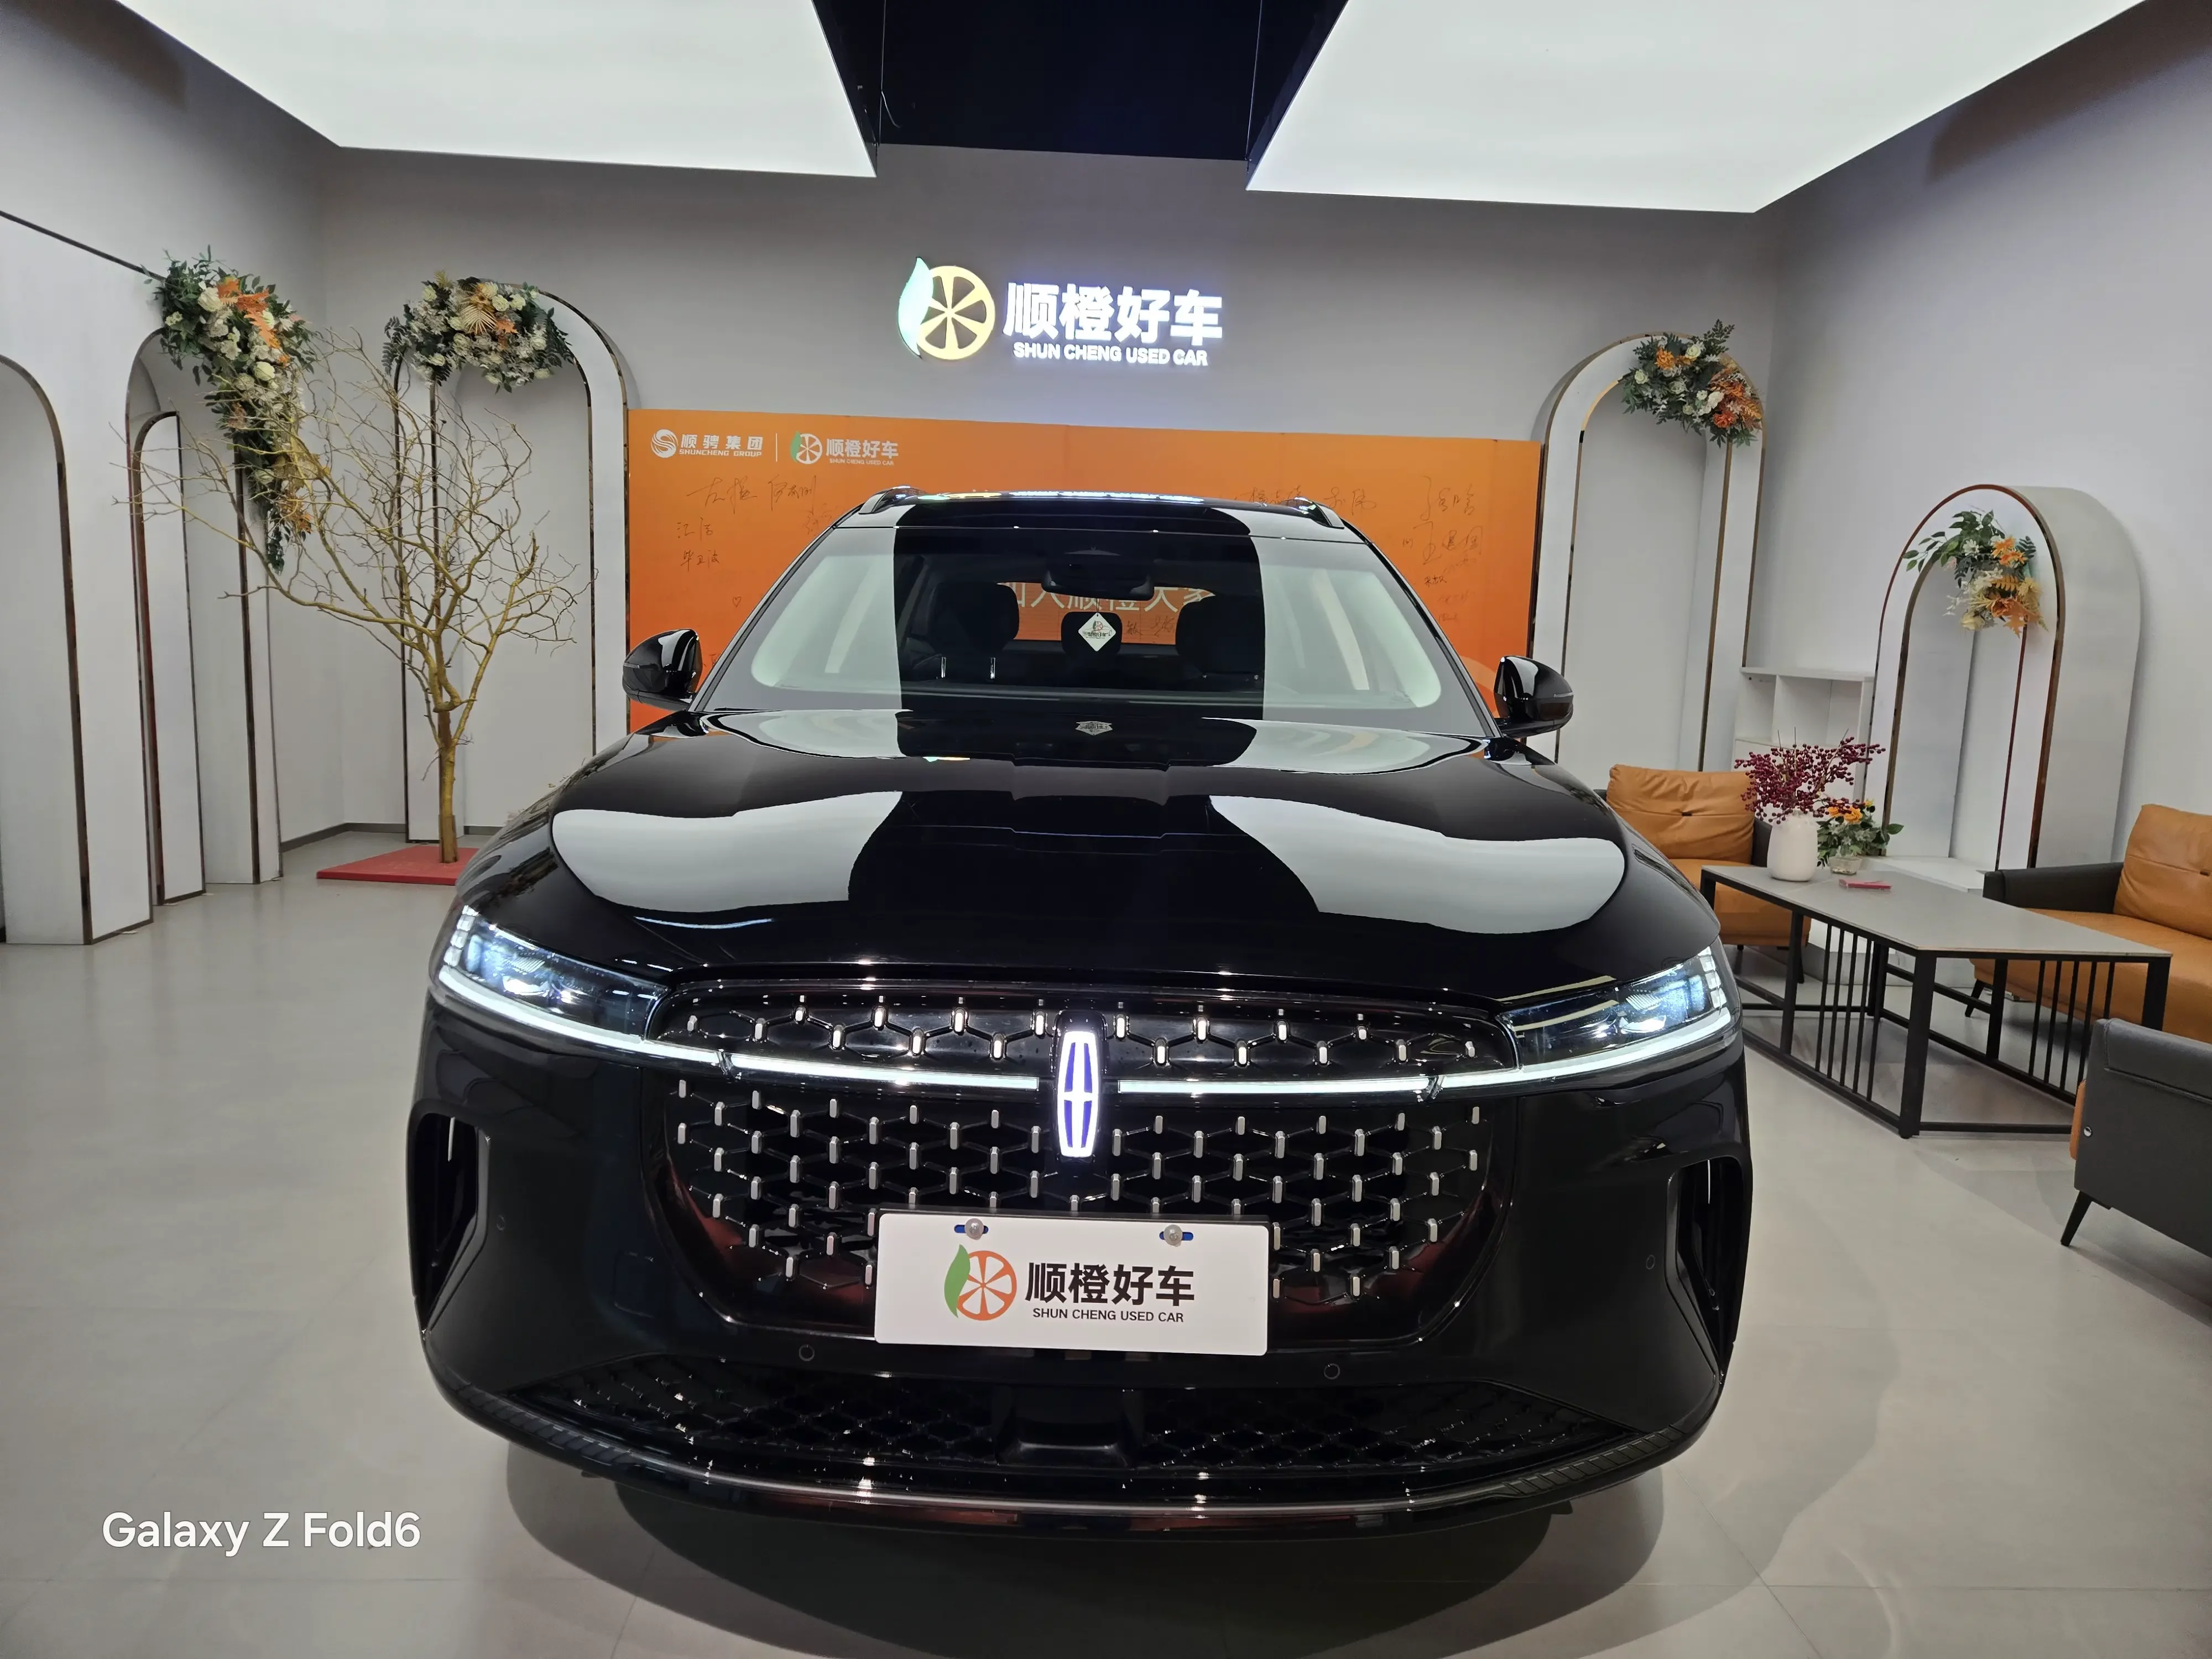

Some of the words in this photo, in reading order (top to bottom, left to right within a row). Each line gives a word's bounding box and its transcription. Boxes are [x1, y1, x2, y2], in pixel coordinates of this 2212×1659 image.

[1003, 282, 1223, 346] 顺橙好车
[1013, 342, 1060, 359] SHUN
[1064, 345, 1122, 362] CHENG
[1126, 347, 1171, 364] USED
[1173, 349, 1208, 366] CAR
[681, 434, 763, 450] 顺骋集团
[826, 439, 899, 459] 顺橙好车
[1025, 1262, 1194, 1306] 顺橙好车
[1032, 1308, 1068, 1319] SHUN
[1072, 1308, 1117, 1321] CHENG
[1120, 1310, 1154, 1322] USED
[1158, 1312, 1184, 1323] CAR
